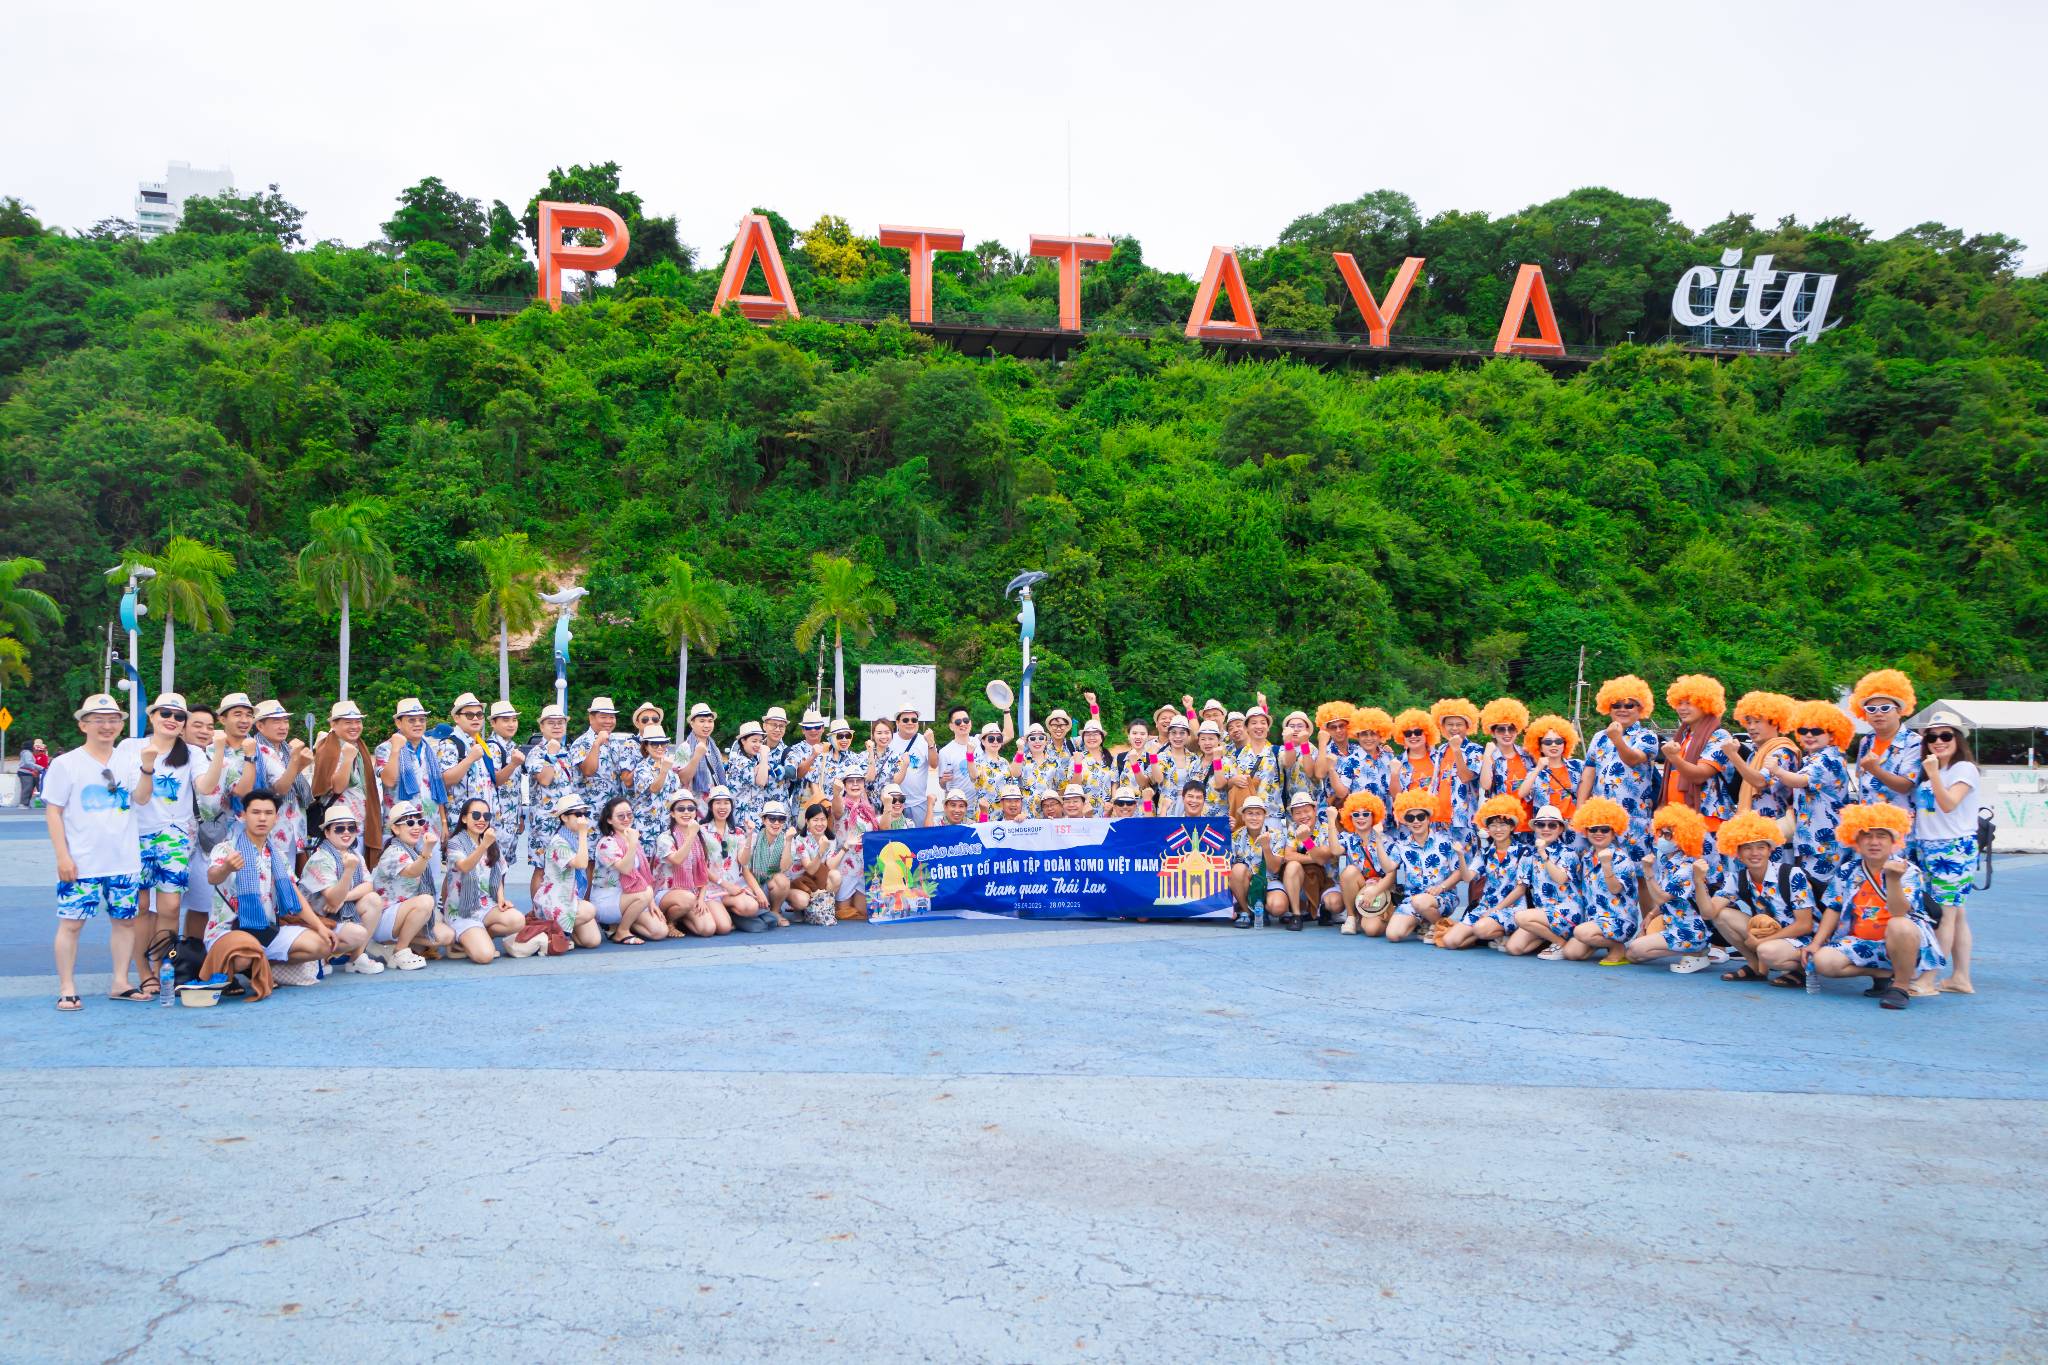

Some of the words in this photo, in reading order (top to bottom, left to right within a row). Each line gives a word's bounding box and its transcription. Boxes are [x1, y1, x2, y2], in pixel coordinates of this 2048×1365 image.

[538, 200, 1565, 356] PATTAYA
[1672, 248, 1843, 352] city
[930, 864, 958, 880] CÔNG
[961, 864, 973, 877] TY
[1023, 857, 1040, 875] TẬP
[1075, 859, 1104, 872] SOMO
[1108, 856, 1130, 874] VIỆT
[1135, 858, 1158, 872] NAM
[985, 881, 1017, 896] tham
[1019, 884, 1048, 900] quan
[1052, 877, 1079, 894] Thái
[1082, 878, 1106, 894] Lan
